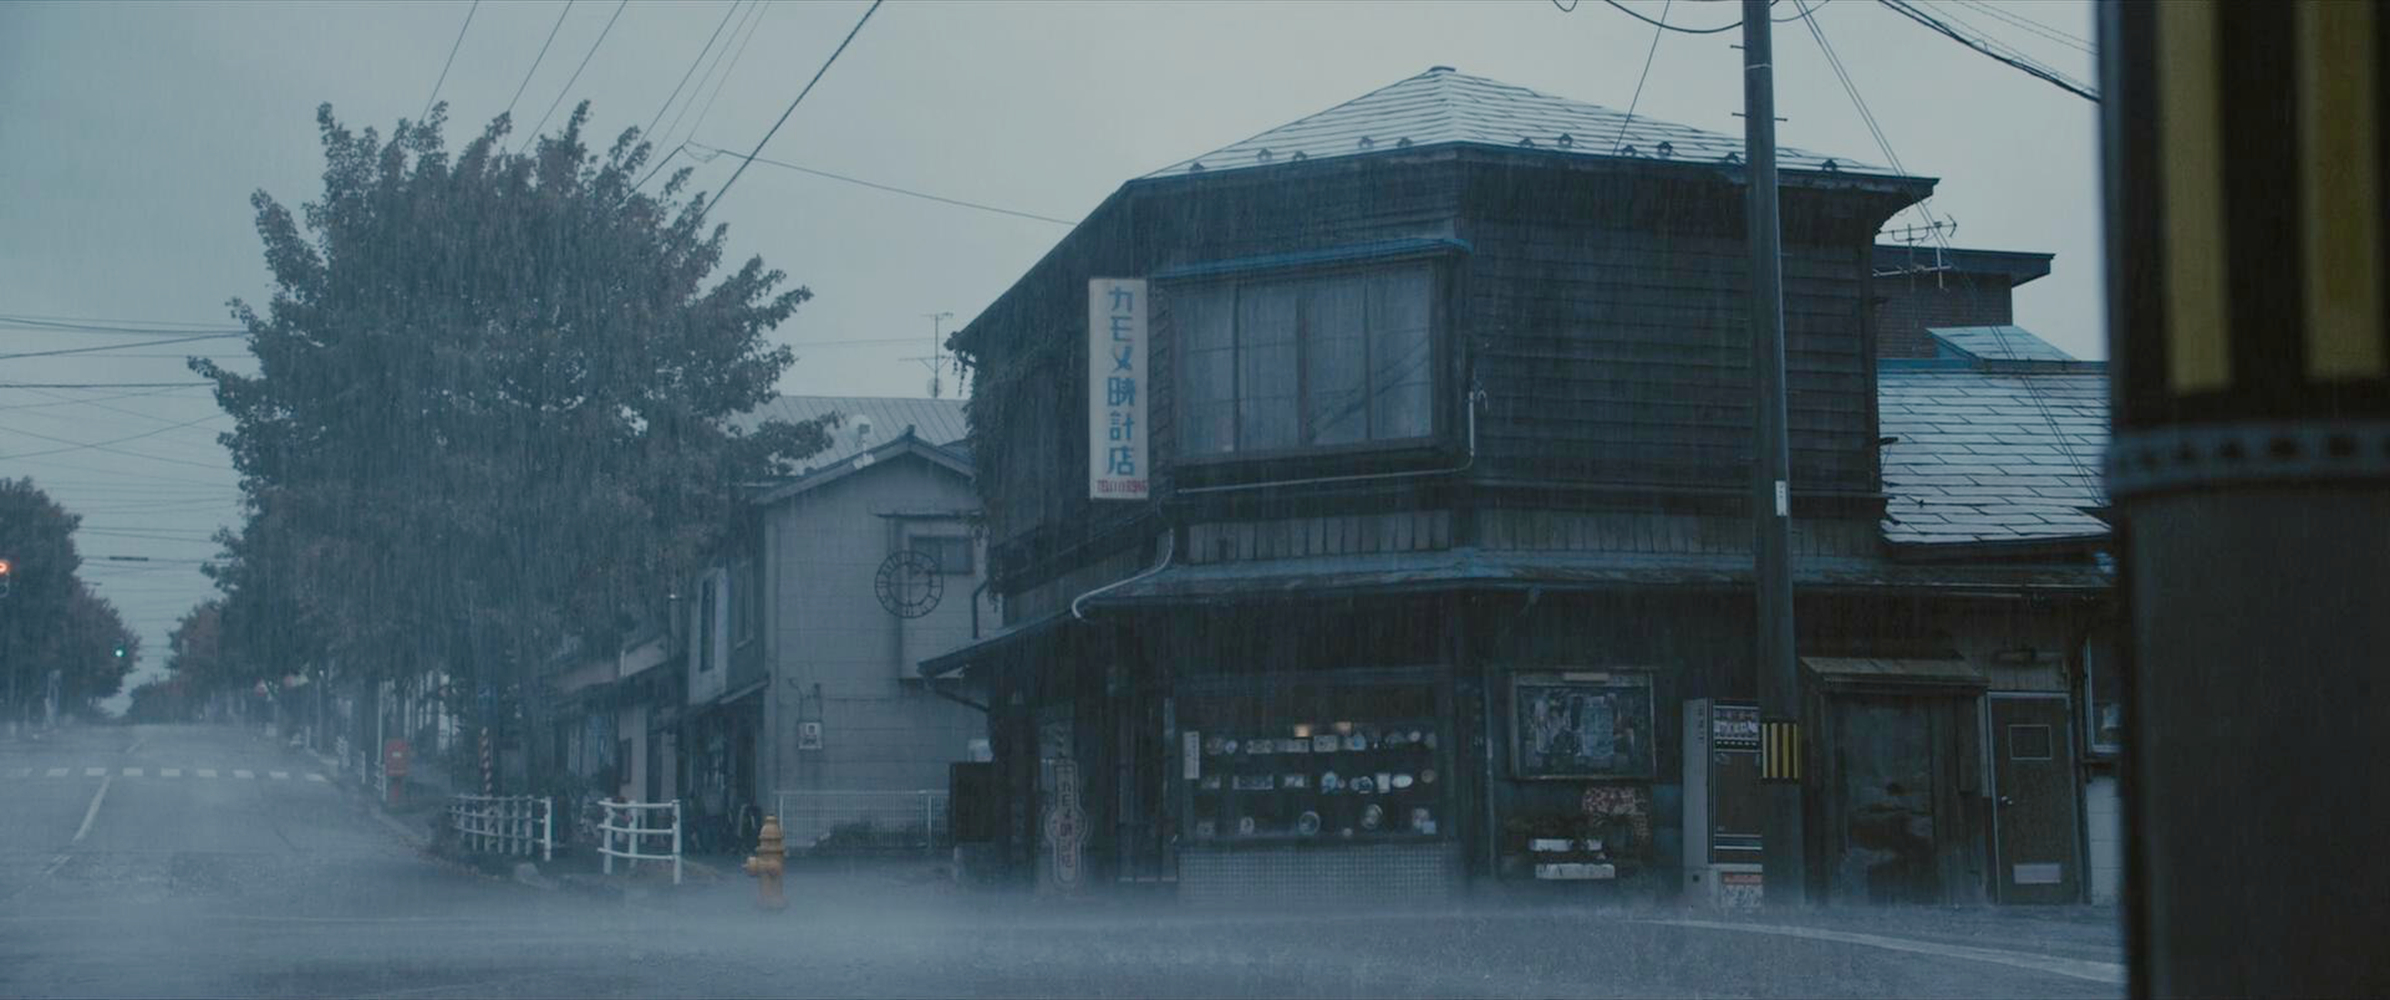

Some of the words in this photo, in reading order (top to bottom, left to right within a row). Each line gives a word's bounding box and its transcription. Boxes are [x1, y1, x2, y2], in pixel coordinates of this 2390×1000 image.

[1107, 286, 1136, 477] カモメ時計店
